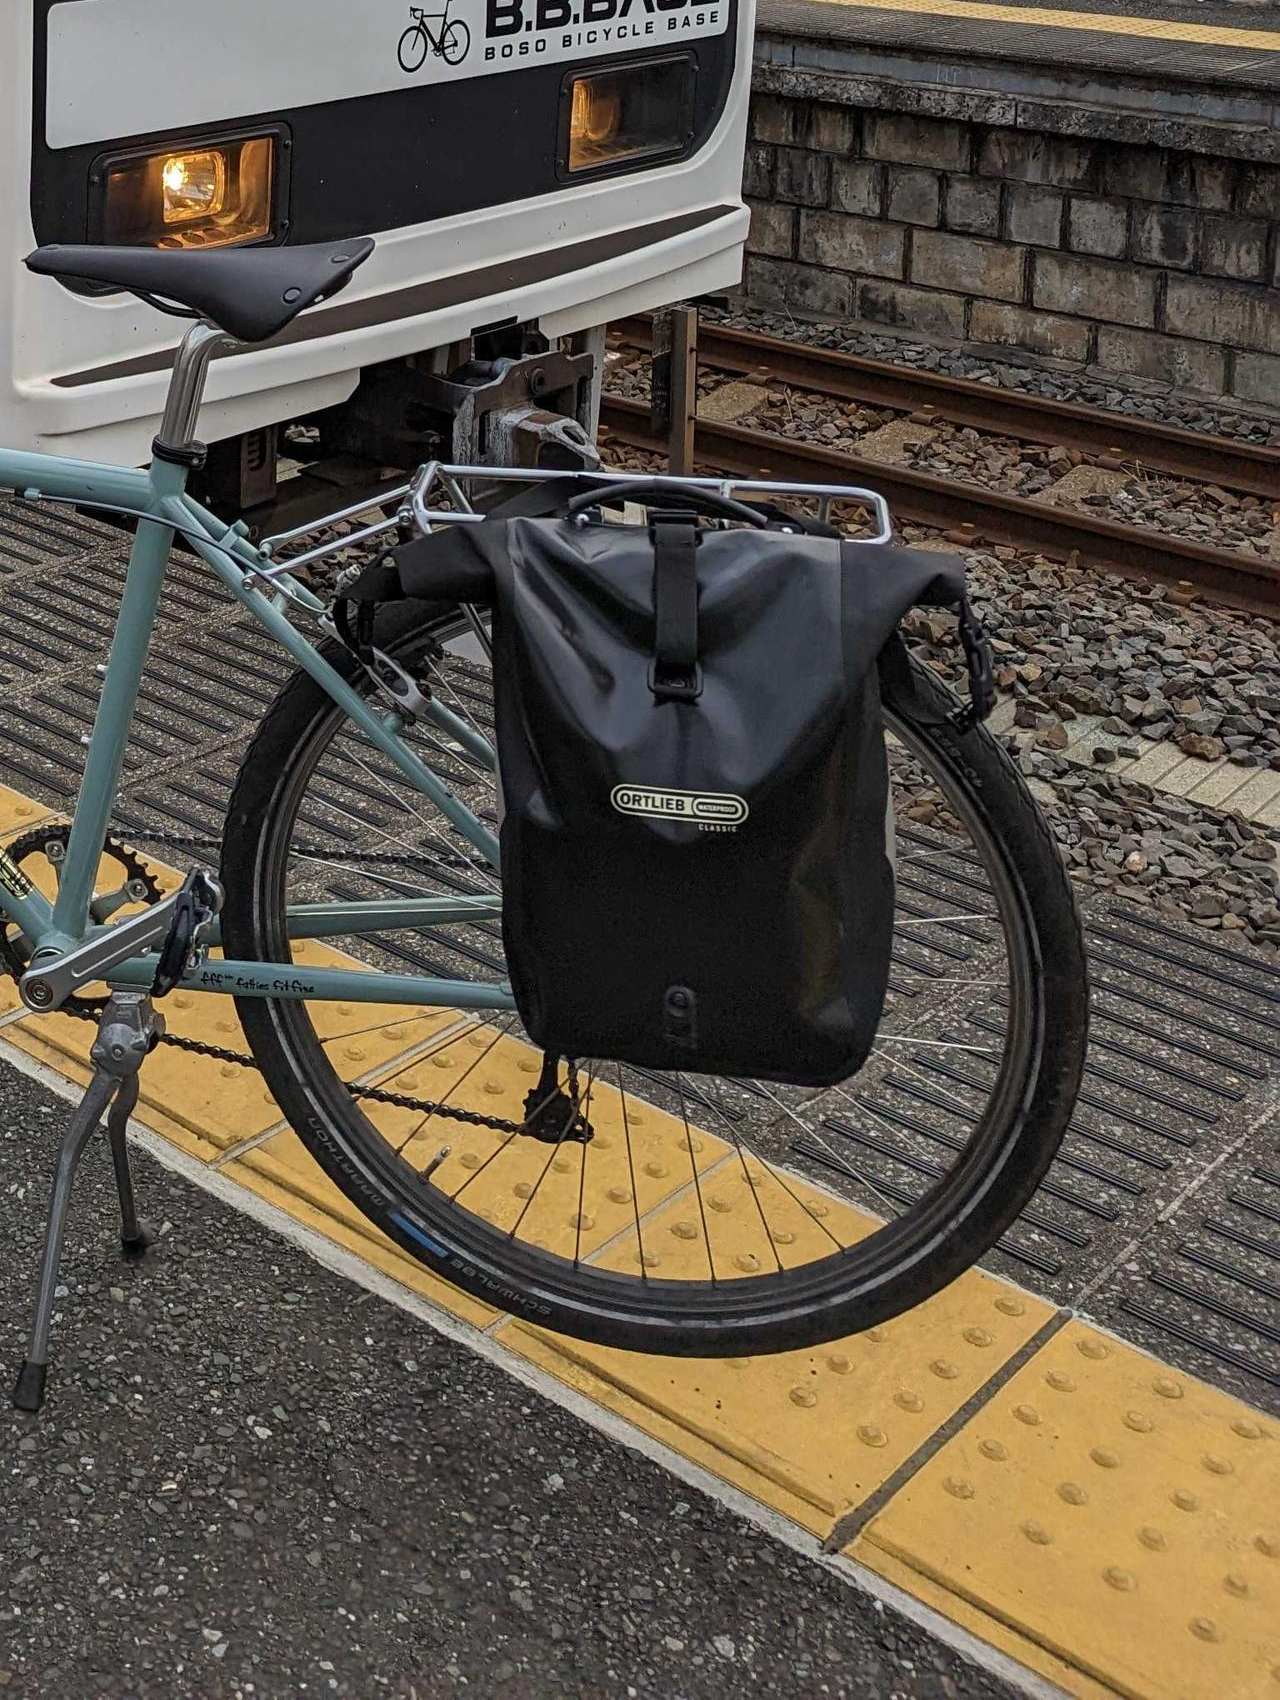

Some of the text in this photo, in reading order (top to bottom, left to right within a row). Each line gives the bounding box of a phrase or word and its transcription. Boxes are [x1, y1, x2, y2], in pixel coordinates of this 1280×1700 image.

[484, 10, 719, 61] BOSO BICYCLE BASE
[620, 792, 685, 812] ORTLIEB
[698, 823, 737, 833] CLASSIC
[307, 1117, 386, 1206] MARATHON
[449, 1258, 553, 1316] SCHWALBE
